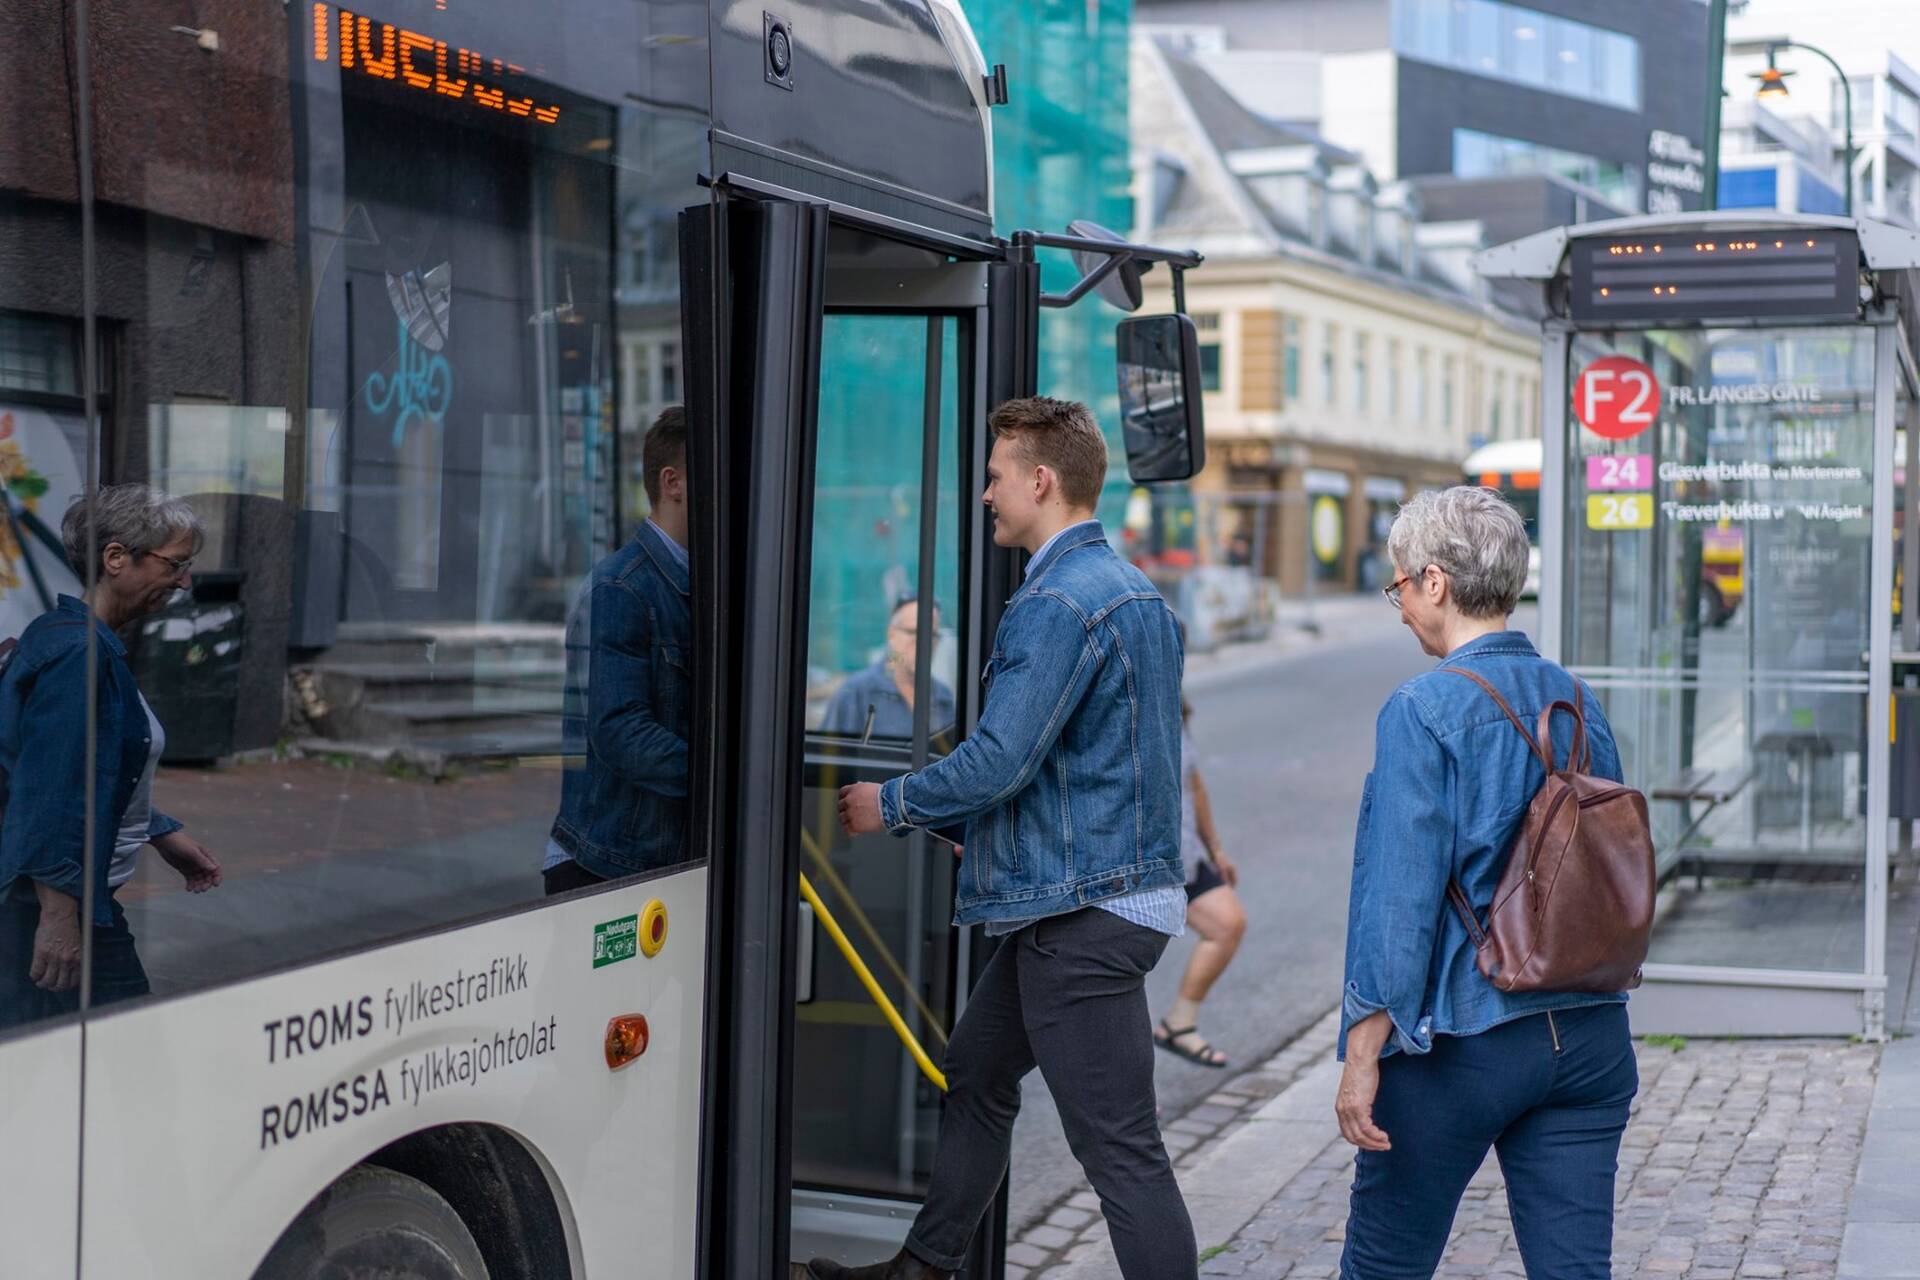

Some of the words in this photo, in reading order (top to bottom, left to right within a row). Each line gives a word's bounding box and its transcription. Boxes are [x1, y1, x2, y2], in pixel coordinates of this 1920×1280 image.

[1583, 369, 1653, 424] F2
[1669, 386, 1696, 405] FR.
[1699, 384, 1770, 403] LANGES
[1772, 383, 1821, 401] GATE
[1600, 458, 1639, 486] 24
[1773, 467, 1789, 480] via
[1790, 466, 1862, 481] Mortensnes
[1600, 497, 1639, 526] 26
[264, 996, 374, 1064] TROMS
[384, 953, 529, 1036] fylkestrafikk
[261, 1068, 391, 1150] ROMSSA
[400, 1015, 557, 1107] fylkkajohtolat
